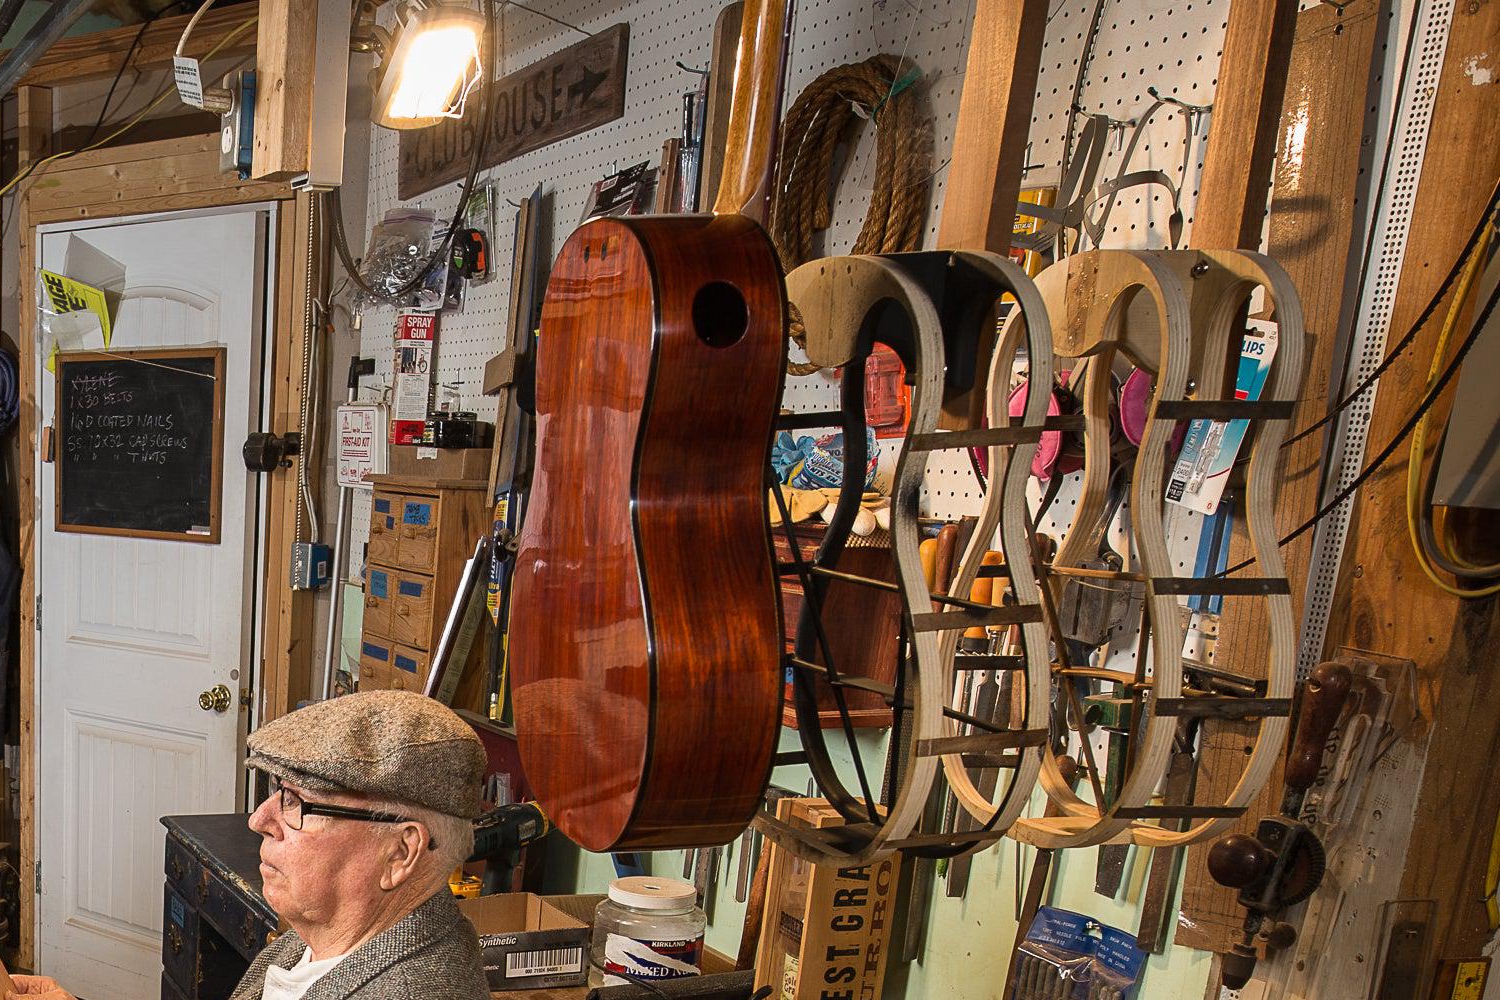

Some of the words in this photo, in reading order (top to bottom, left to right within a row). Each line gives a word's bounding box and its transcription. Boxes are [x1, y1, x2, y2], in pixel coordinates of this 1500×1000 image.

[407, 316, 432, 328] SPRAY
[411, 328, 427, 339] GUN
[137, 414, 174, 430] NAILS
